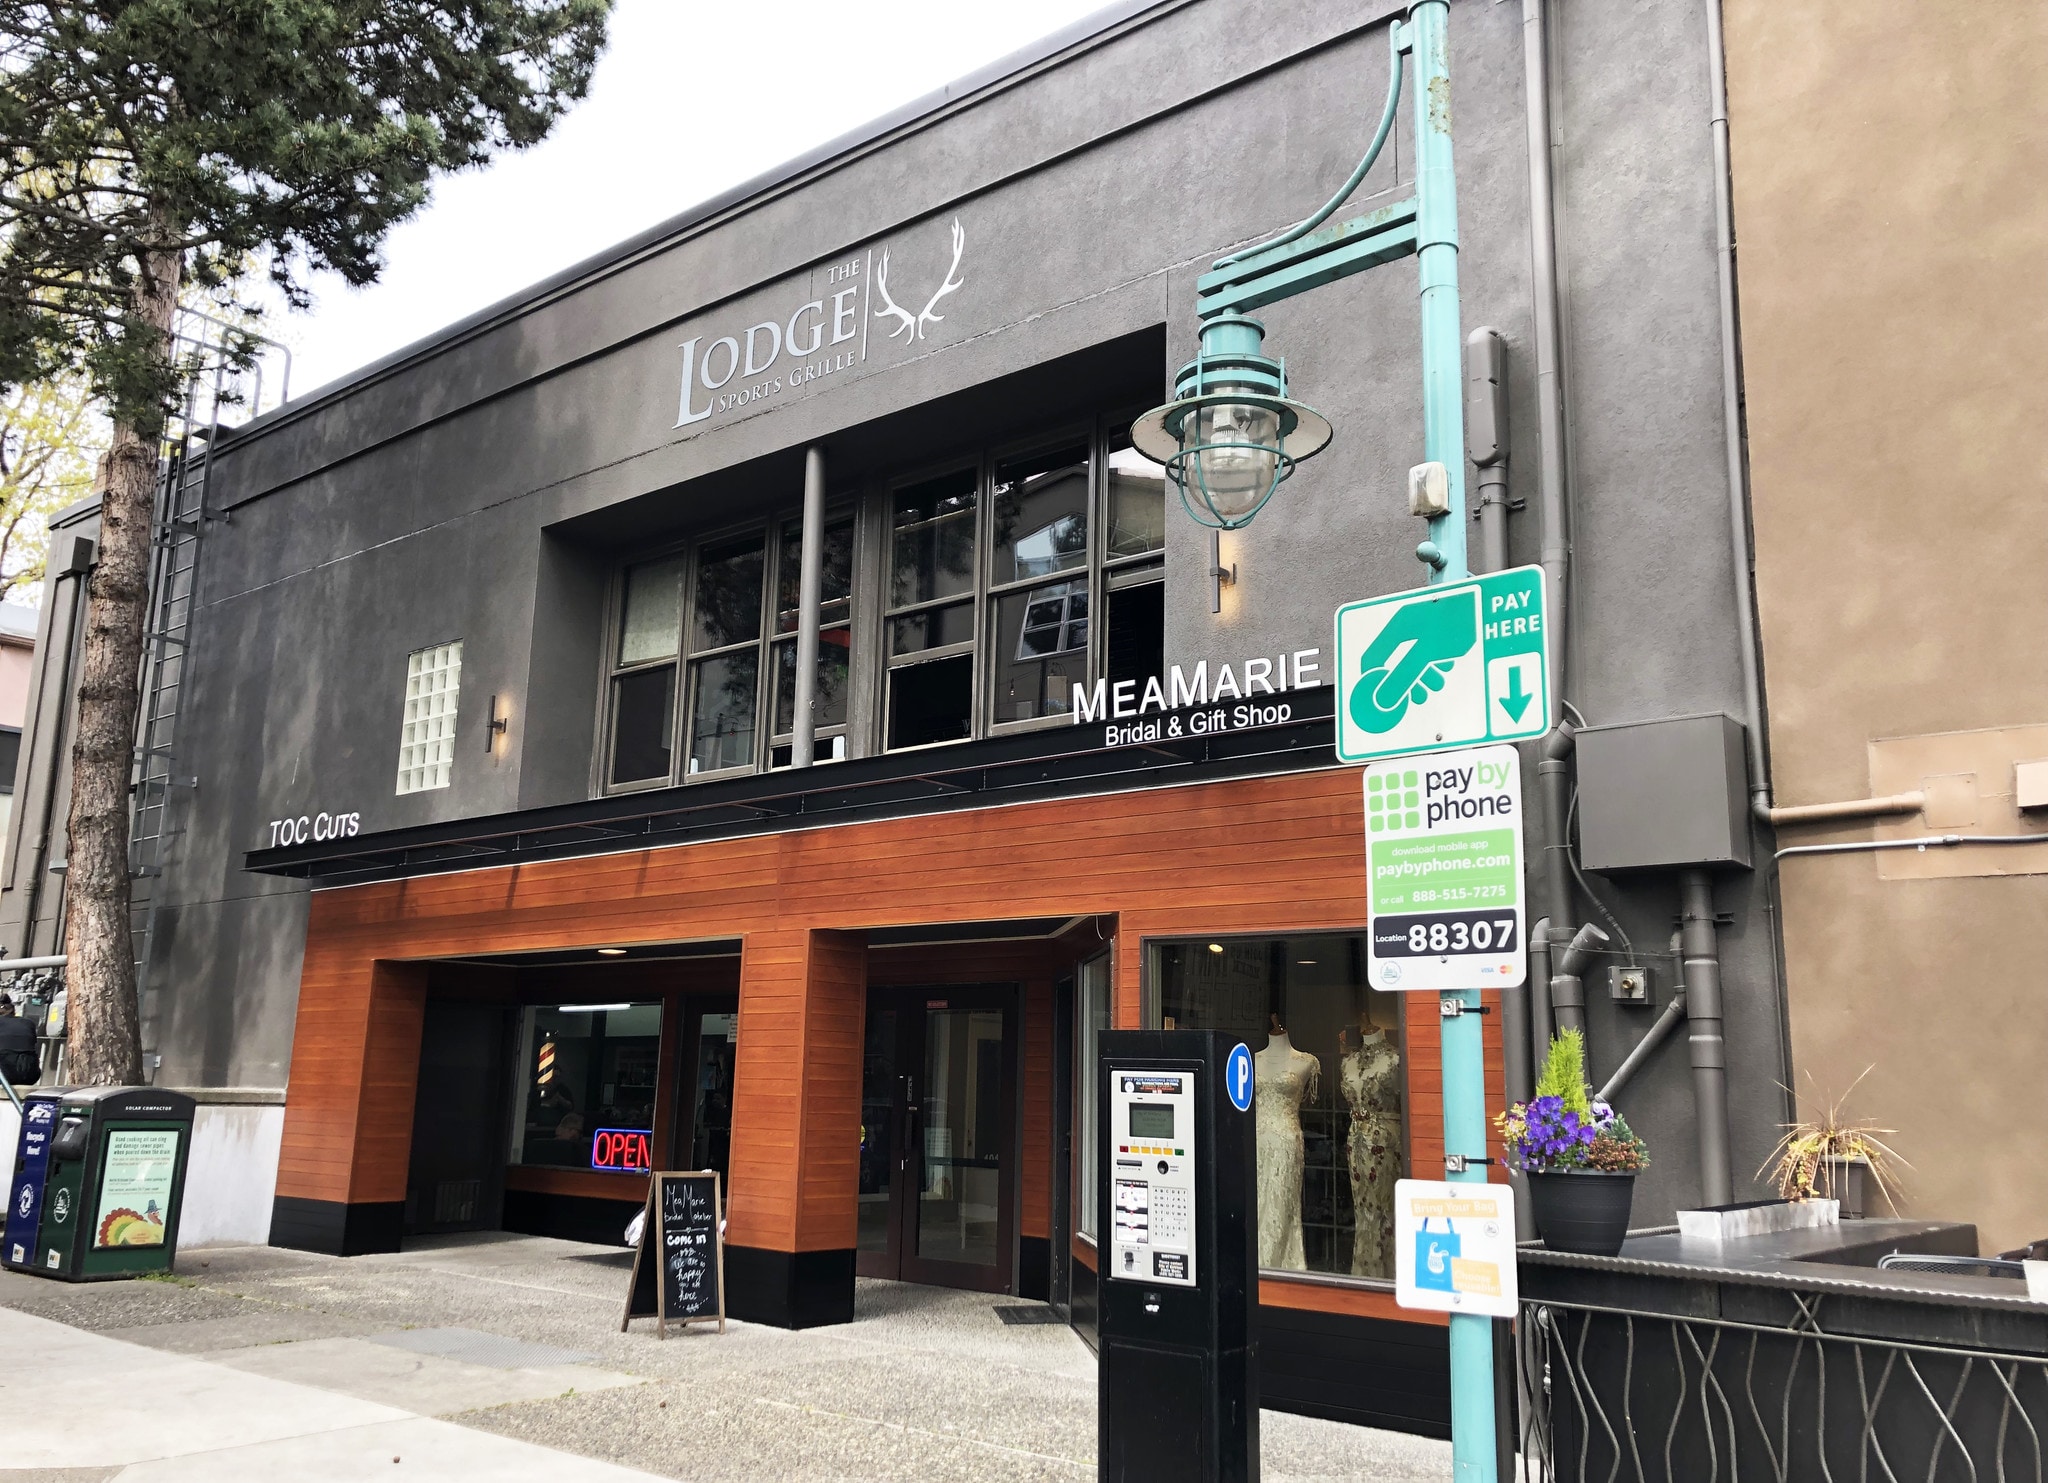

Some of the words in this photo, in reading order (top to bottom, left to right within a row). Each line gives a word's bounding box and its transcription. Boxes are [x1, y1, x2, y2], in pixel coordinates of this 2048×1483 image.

[828, 258, 860, 285] THE
[671, 285, 859, 430] LODGE
[718, 376, 782, 413] SPORTS
[789, 351, 856, 387] GRILLE
[1491, 589, 1532, 614] PAY
[1485, 614, 1541, 640] HERE
[1105, 719, 1161, 747] Bridal
[1167, 716, 1183, 738] &
[1189, 710, 1227, 734] Gift
[1233, 703, 1292, 728] Shop
[1427, 793, 1512, 829] phone
[270, 815, 310, 848] TOC
[1391, 843, 1435, 856] download
[1437, 841, 1468, 852] mobile
[1470, 840, 1489, 851] app
[1376, 854, 1511, 879] paybyphone.com
[1390, 895, 1404, 904] call
[1412, 885, 1506, 903] 888-515-7275
[1375, 933, 1407, 943] Location
[1408, 919, 1514, 952] 88307
[595, 1132, 650, 1167] OPEN
[1414, 1203, 1444, 1215] Bring
[1446, 1203, 1471, 1213] Your
[1473, 1200, 1495, 1213] Bag
